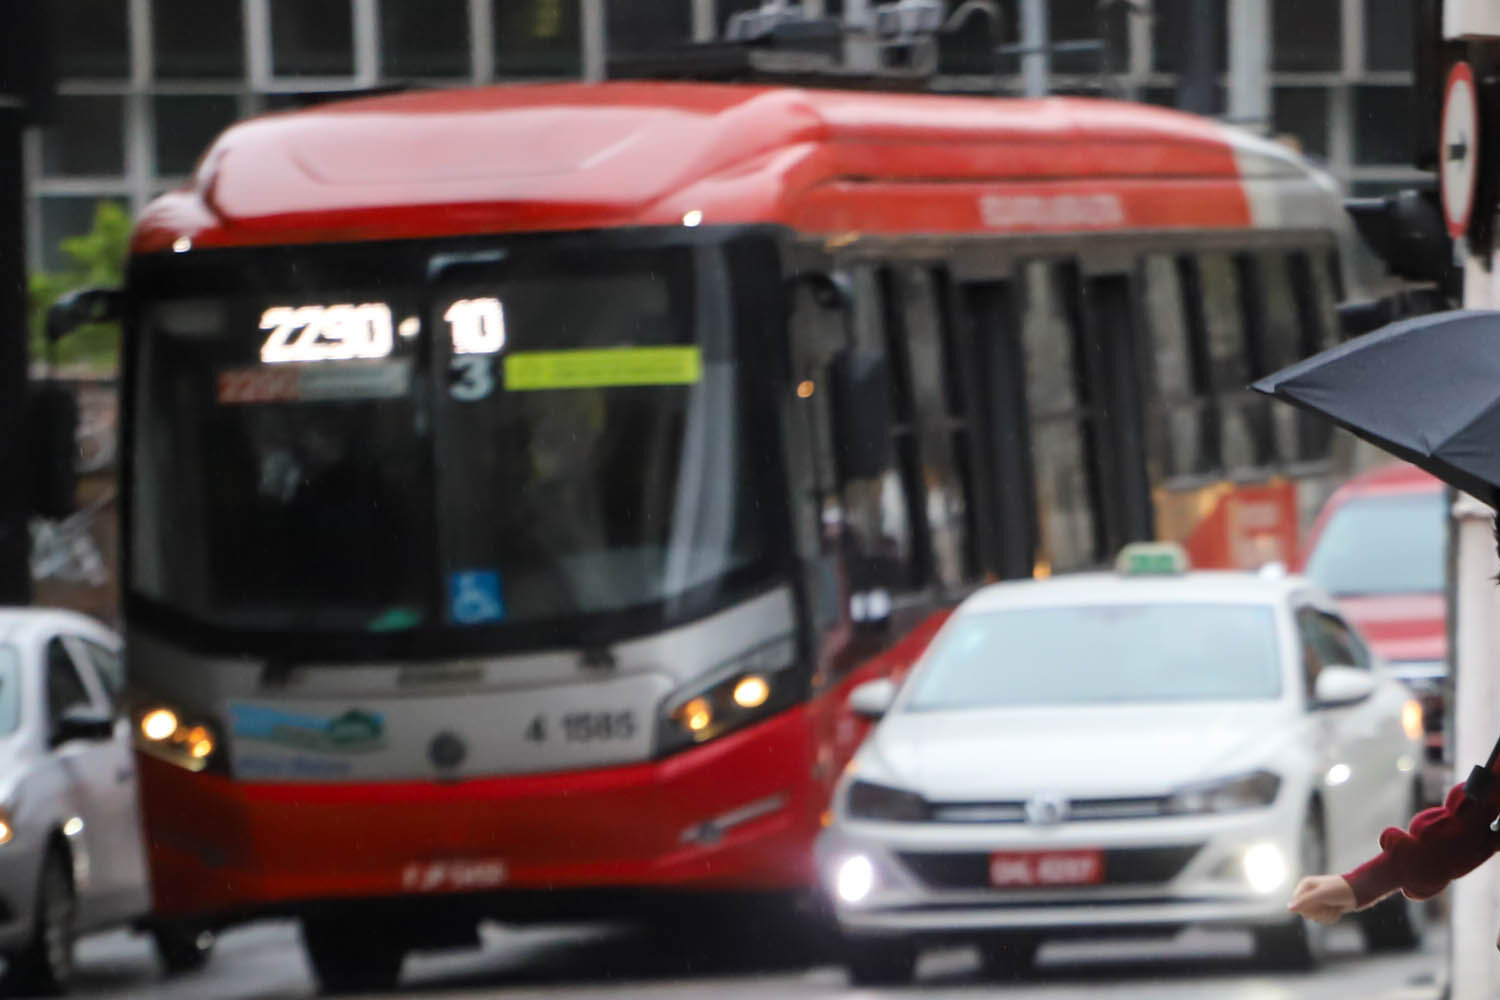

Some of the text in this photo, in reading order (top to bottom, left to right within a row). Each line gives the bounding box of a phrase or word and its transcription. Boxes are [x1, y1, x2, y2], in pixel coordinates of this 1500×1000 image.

[259, 302, 393, 363] 2290
[444, 297, 505, 353] 10
[450, 354, 496, 400] 3
